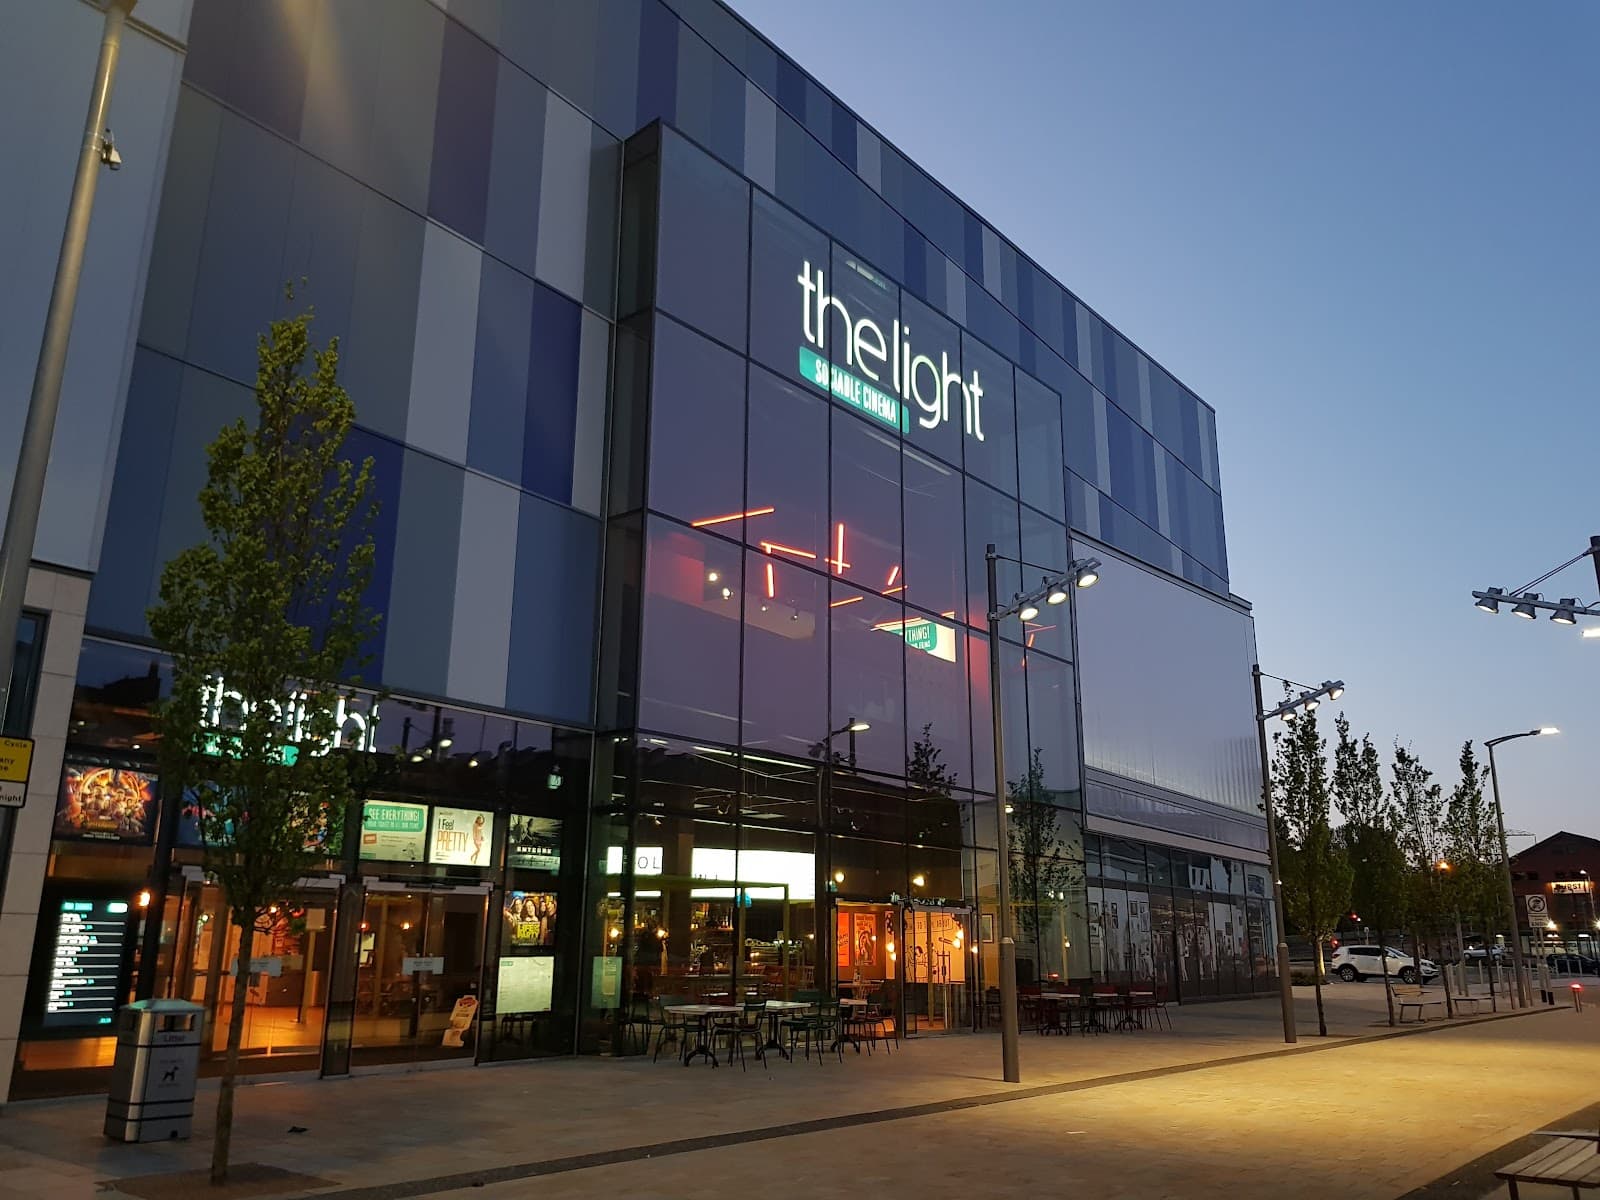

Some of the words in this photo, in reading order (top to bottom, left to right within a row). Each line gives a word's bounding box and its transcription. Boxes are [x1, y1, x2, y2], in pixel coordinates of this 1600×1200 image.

[815, 358, 861, 405] SOIABLE
[863, 382, 897, 424] CINEMA
[368, 808, 379, 820] SEE
[442, 818, 455, 831] Feel
[436, 830, 469, 852] PRETTY
